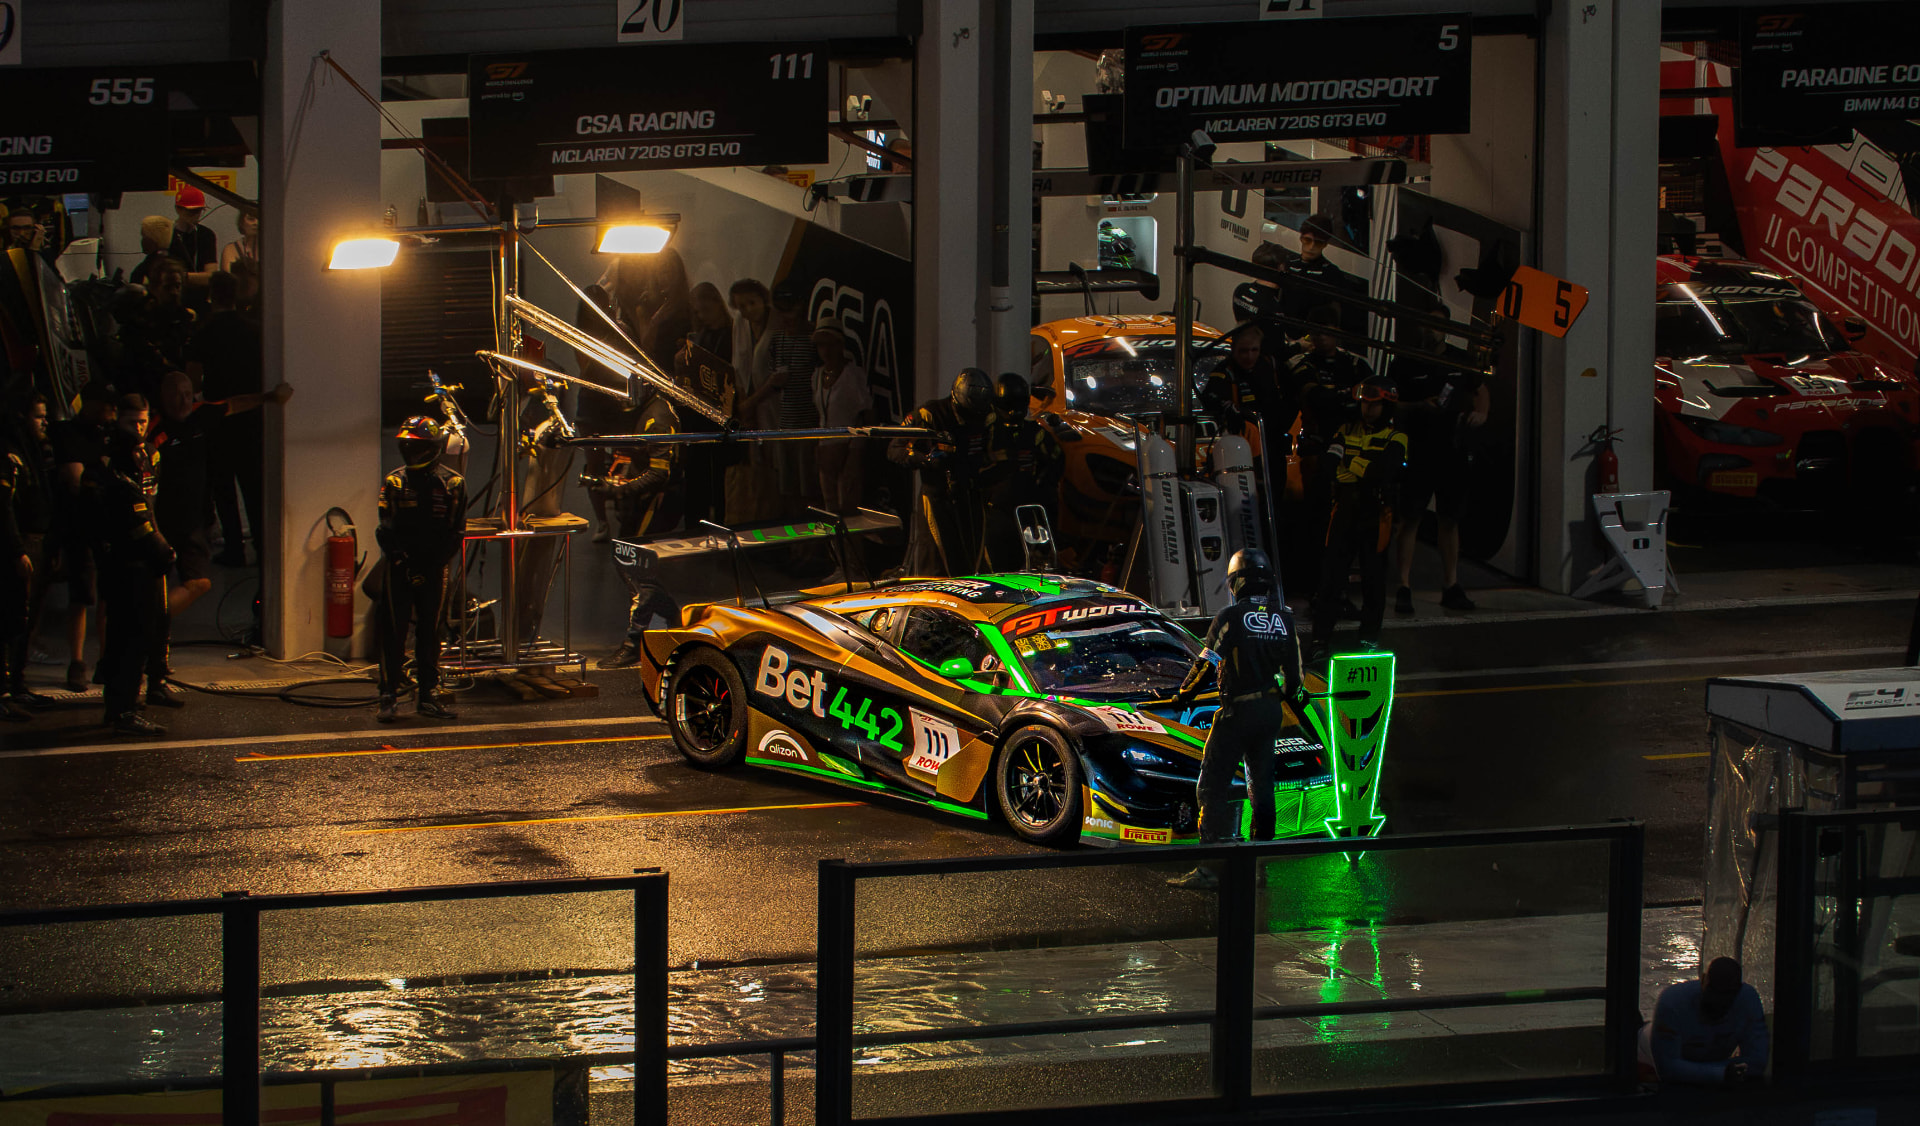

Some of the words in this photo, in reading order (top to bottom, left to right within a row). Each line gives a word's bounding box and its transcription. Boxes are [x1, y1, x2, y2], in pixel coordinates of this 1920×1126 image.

[1438, 24, 1461, 51] 5
[769, 52, 815, 80] 111
[1781, 65, 1889, 89] PARADINE
[88, 77, 155, 106] 555
[1155, 83, 1268, 109] OPTIMUM
[1270, 75, 1440, 103] MOTORSPORT
[1844, 97, 1883, 113] BMW
[1882, 96, 1906, 111] M4
[576, 114, 623, 135] CSA
[628, 109, 716, 133] RACING
[1204, 117, 1277, 134] MCLAREN
[1279, 115, 1321, 130] 720S
[1322, 112, 1355, 128] GT3
[1355, 111, 1388, 126] EVO
[552, 147, 626, 165] MCLAREN
[628, 145, 672, 160] 720S
[673, 142, 706, 158] GT3
[707, 141, 742, 157] EVO
[9, 169, 44, 184] GT3
[45, 167, 80, 183] EVO
[1261, 168, 1322, 184] PORTER
[1161, 480, 1180, 565] OPTIMUM
[615, 543, 637, 558] aws
[1243, 611, 1288, 636] CSA
[1347, 666, 1378, 683] #111
[1108, 711, 1145, 725] 111
[1116, 723, 1155, 731] ROWE
[769, 743, 798, 759] alizon
[924, 726, 950, 760] 111
[1124, 827, 1168, 842] PIRELLI
